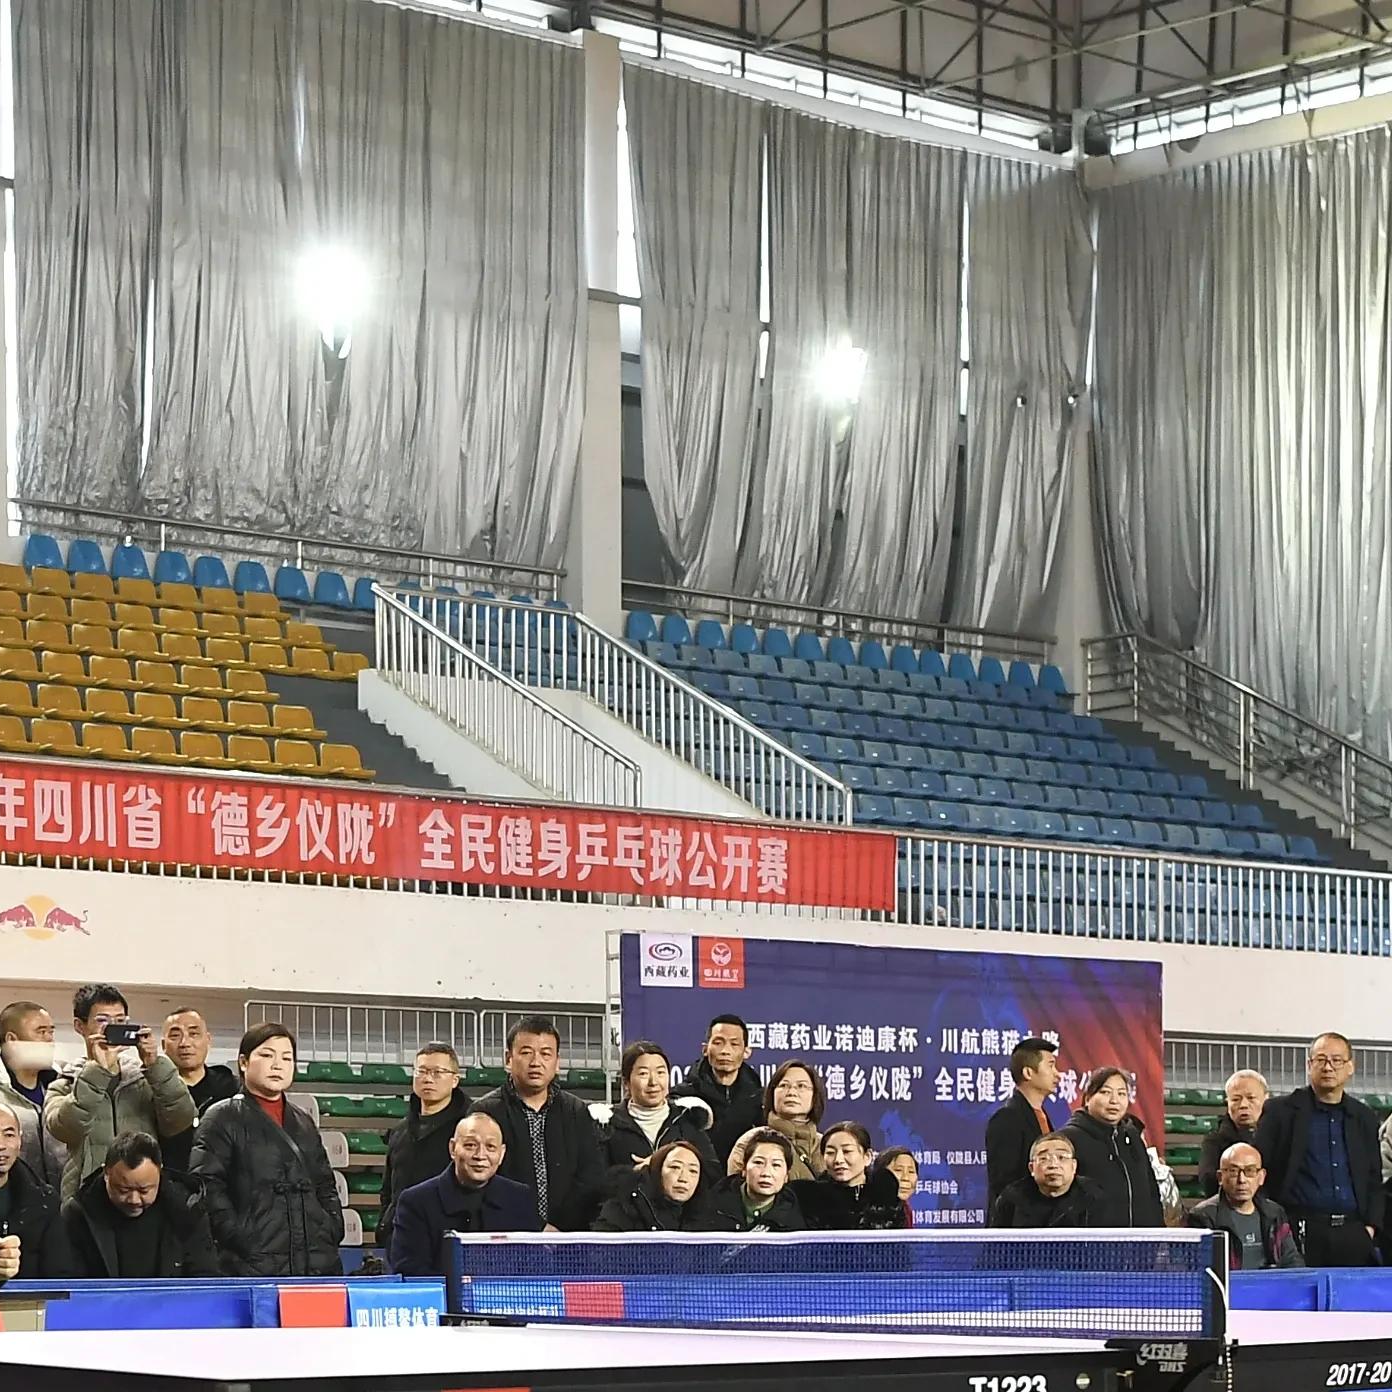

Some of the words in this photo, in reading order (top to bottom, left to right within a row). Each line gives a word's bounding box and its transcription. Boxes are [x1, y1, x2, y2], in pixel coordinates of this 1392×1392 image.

[418, 808, 788, 896] 全民健身乒乓球公开赛
